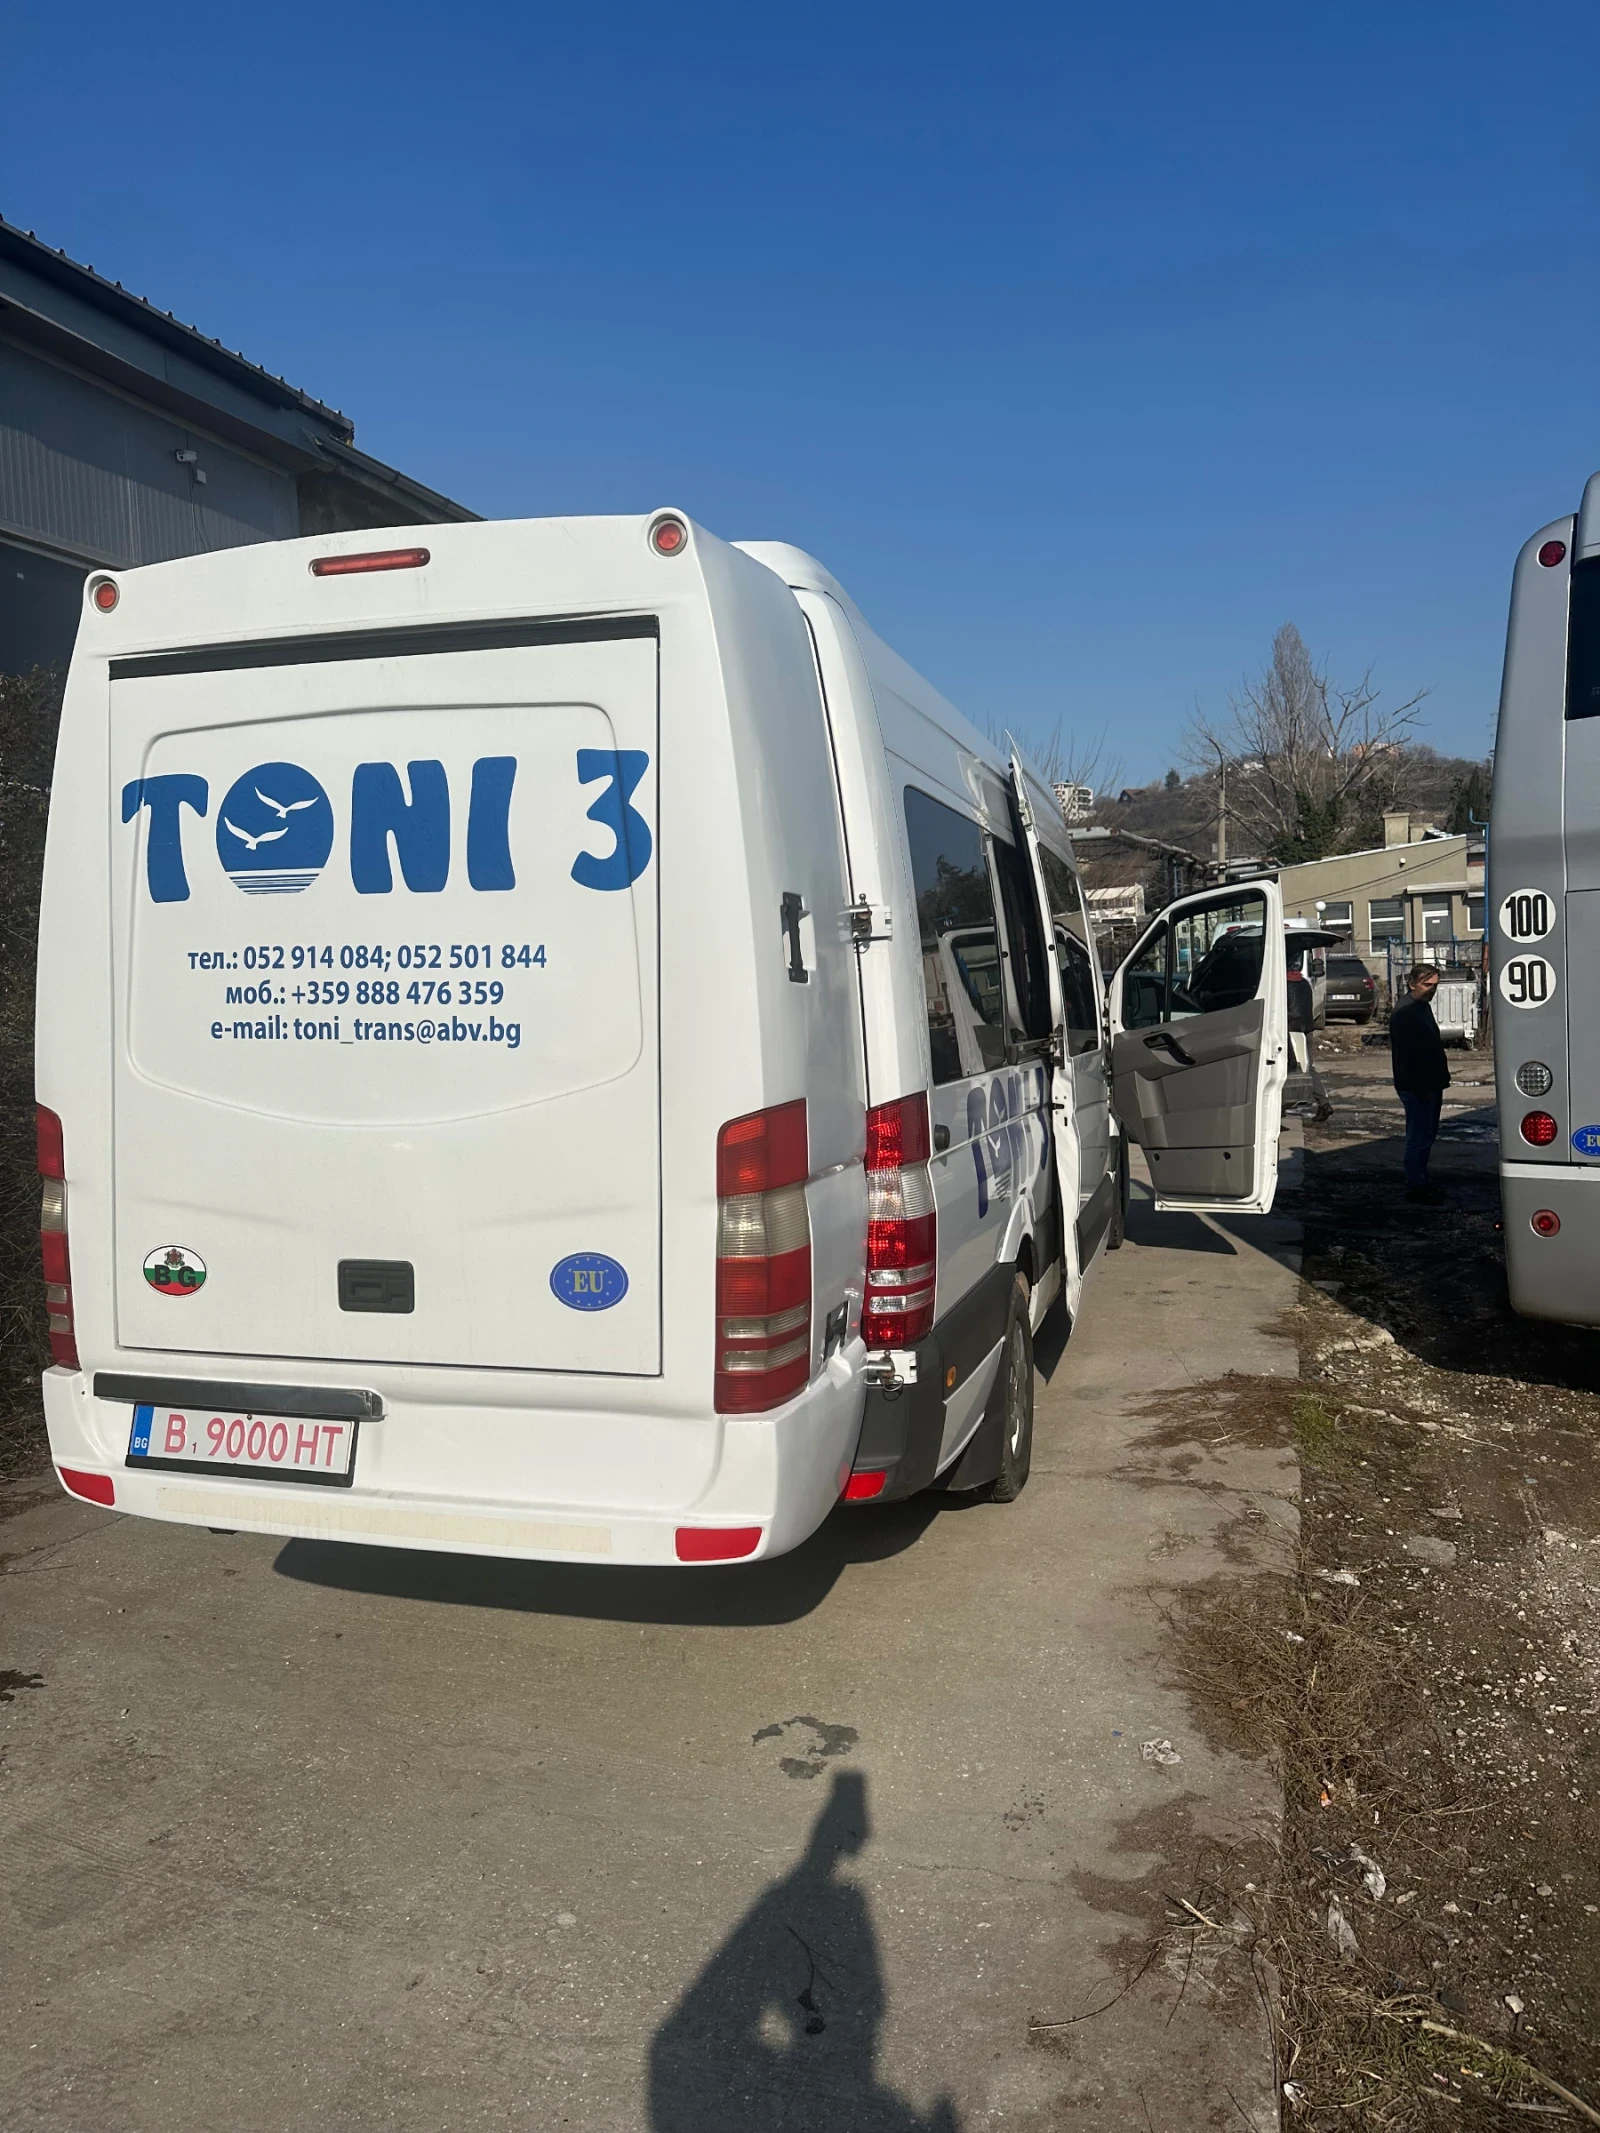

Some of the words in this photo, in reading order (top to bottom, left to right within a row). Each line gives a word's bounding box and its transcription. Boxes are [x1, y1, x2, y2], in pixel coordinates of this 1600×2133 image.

[122, 756, 517, 904] TONI
[571, 748, 653, 891] 3
[1505, 893, 1548, 938] 100
[187, 951, 238, 970] тел.:
[243, 945, 285, 970] 052
[291, 945, 334, 969] 914
[340, 944, 392, 973] 084;
[397, 944, 442, 969] 052
[449, 944, 491, 969] 501
[501, 944, 547, 969] 844
[226, 979, 286, 1005] моб.:
[291, 980, 350, 1005] +359
[355, 980, 401, 1005] 888
[406, 981, 452, 1005] 476
[458, 980, 504, 1005] 359
[1508, 960, 1548, 1003] 90
[211, 1014, 288, 1040] e-mail:
[293, 1015, 521, 1049] toni_trans@abv.bg
[154, 1264, 197, 1288] BG
[572, 1270, 605, 1293] EU
[134, 1437, 148, 1449] BG
